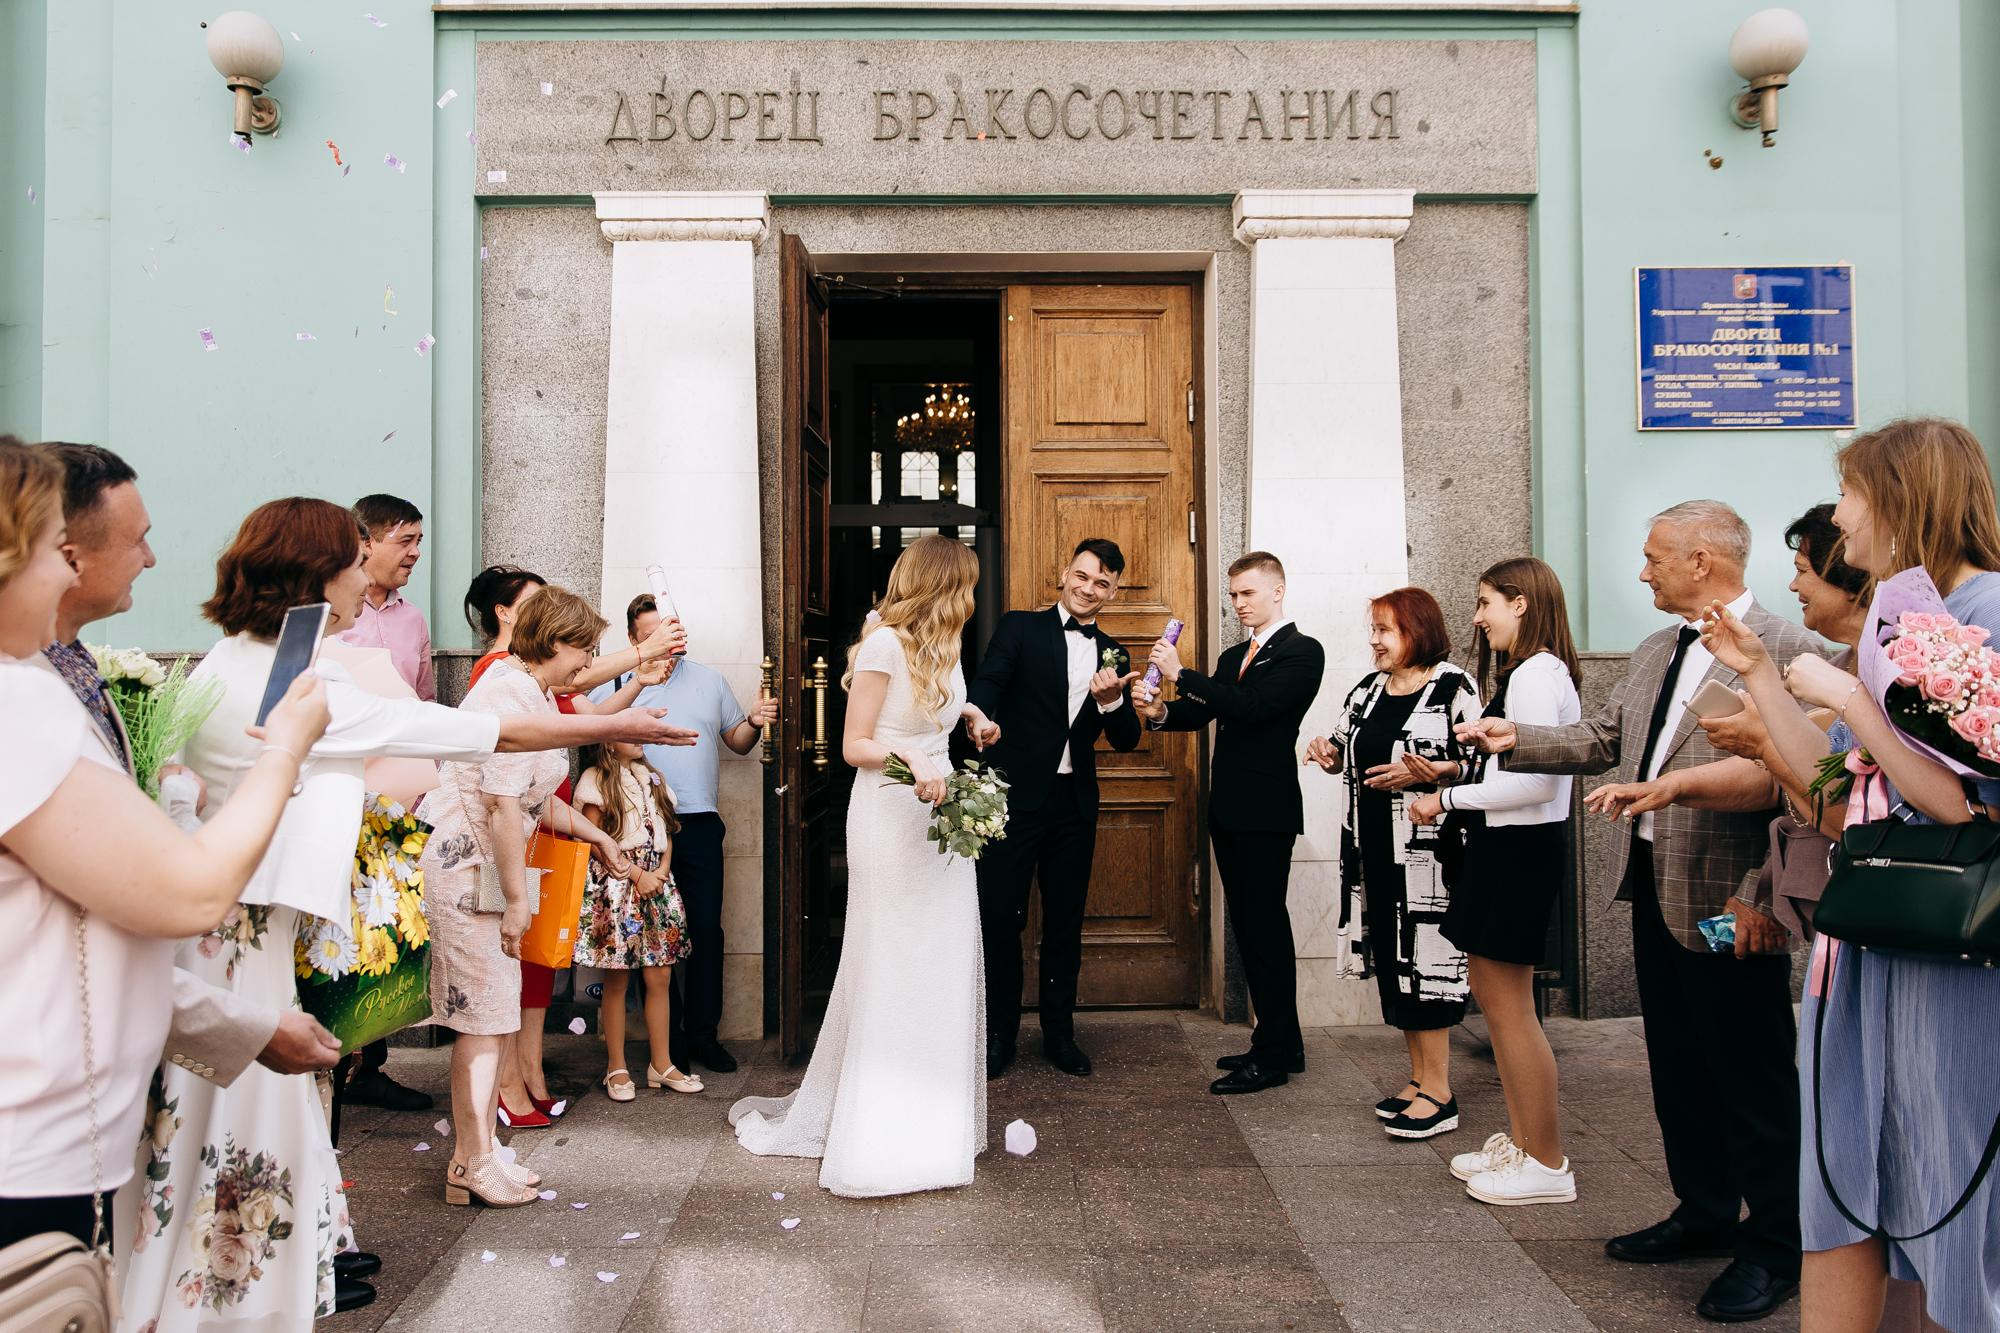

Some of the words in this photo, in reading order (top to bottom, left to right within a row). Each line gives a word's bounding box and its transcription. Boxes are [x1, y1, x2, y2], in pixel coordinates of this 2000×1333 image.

[605, 89, 824, 146] ДВОРЕЦ
[873, 87, 1400, 141] БРАКОСОЧЕТАНИЯ
[1711, 328, 1782, 342] ДВОРЕЦ
[1653, 343, 1810, 356] БРАКОСОЧЕТАНИЯ
[1813, 342, 1839, 355] №1
